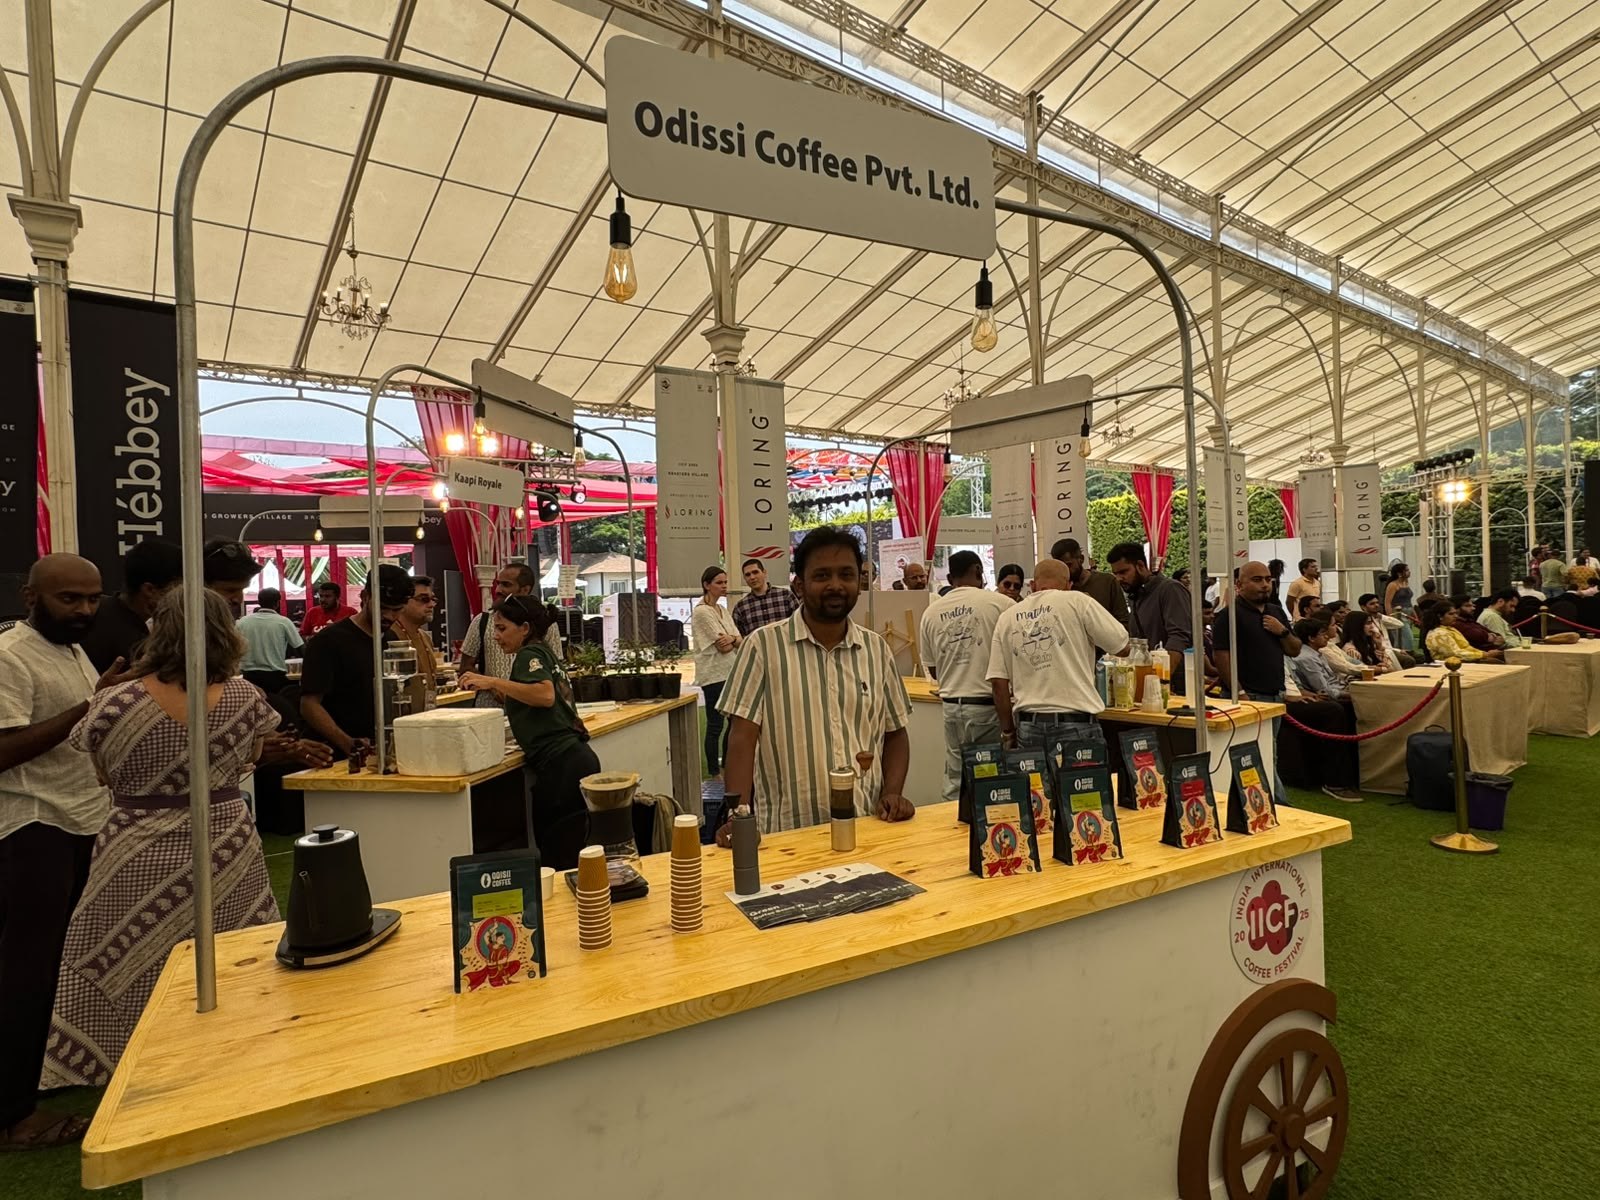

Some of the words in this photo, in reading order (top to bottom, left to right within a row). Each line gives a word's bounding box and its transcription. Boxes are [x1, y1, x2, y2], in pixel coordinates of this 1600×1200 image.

[634, 100, 746, 158] Odissi
[754, 129, 858, 183] Coffee
[865, 153, 922, 197] Pvt.
[928, 168, 980, 210] Ltd.
[454, 471, 477, 487] Kaapi
[477, 476, 503, 491] Royale
[751, 415, 773, 531] LORING
[1056, 442, 1073, 535] LORING
[211, 513, 254, 521] GROWERS
[673, 508, 714, 517] LORING
[1234, 472, 1245, 542] LORING
[1355, 480, 1371, 542] LORING
[491, 878, 512, 888] COFFEE
[1235, 885, 1252, 920] INDIA
[1250, 860, 1308, 897] INTERNATIONAL
[1234, 930, 1246, 944] 20
[1299, 909, 1310, 921] 25
[1250, 898, 1297, 941] IICF
[1243, 956, 1272, 979] COFFEE
[1273, 936, 1305, 976] FESTIVAL
